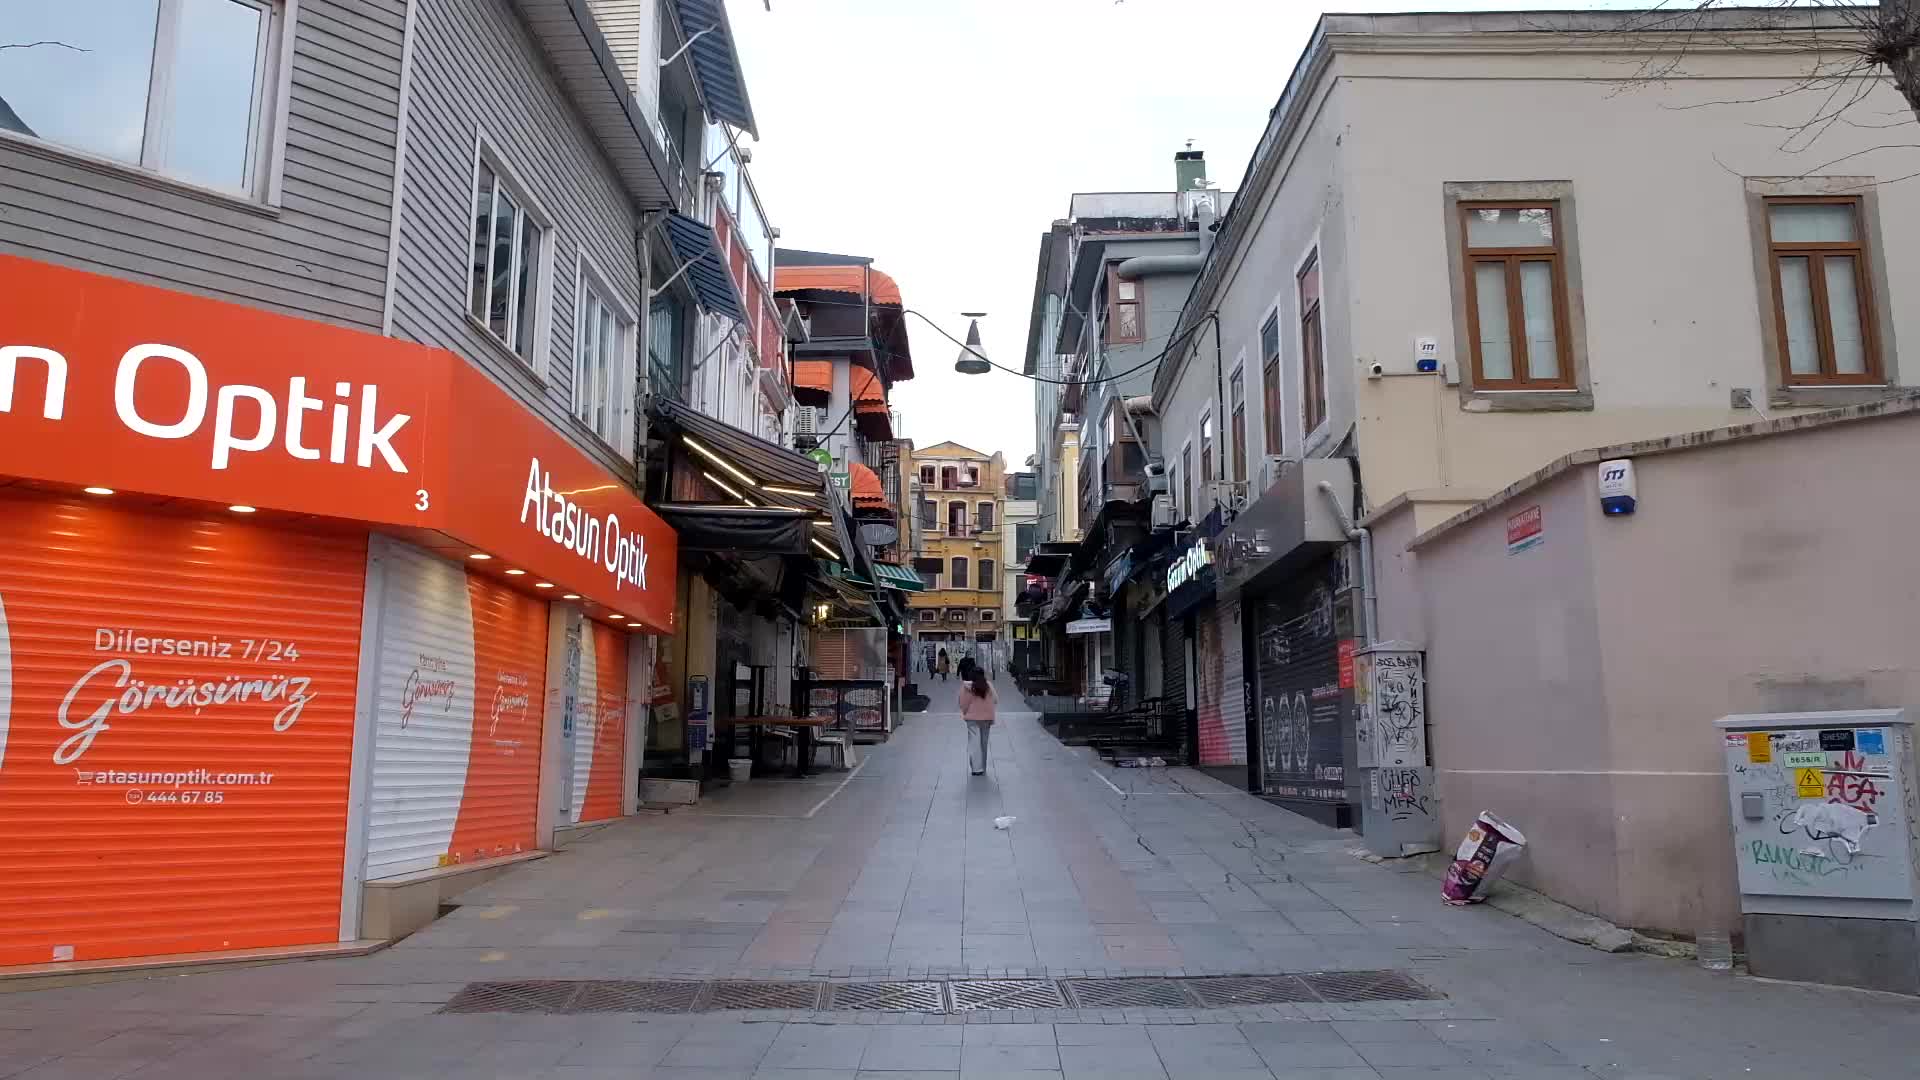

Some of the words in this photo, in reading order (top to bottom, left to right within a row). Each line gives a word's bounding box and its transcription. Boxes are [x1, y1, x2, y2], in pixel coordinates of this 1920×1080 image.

[114, 343, 411, 473] Optik
[1604, 469, 1626, 481] STS
[415, 489, 429, 511] 3
[520, 457, 600, 563] Atasun
[604, 513, 648, 591] Optik
[95, 628, 232, 658] Dilerseniz
[240, 638, 300, 663] 7/24
[53, 659, 318, 764] Görüşürüz
[95, 768, 274, 789] atasunoptik.com.tr
[146, 791, 178, 804] 444
[181, 791, 200, 804] 67
[204, 791, 224, 804] 85
